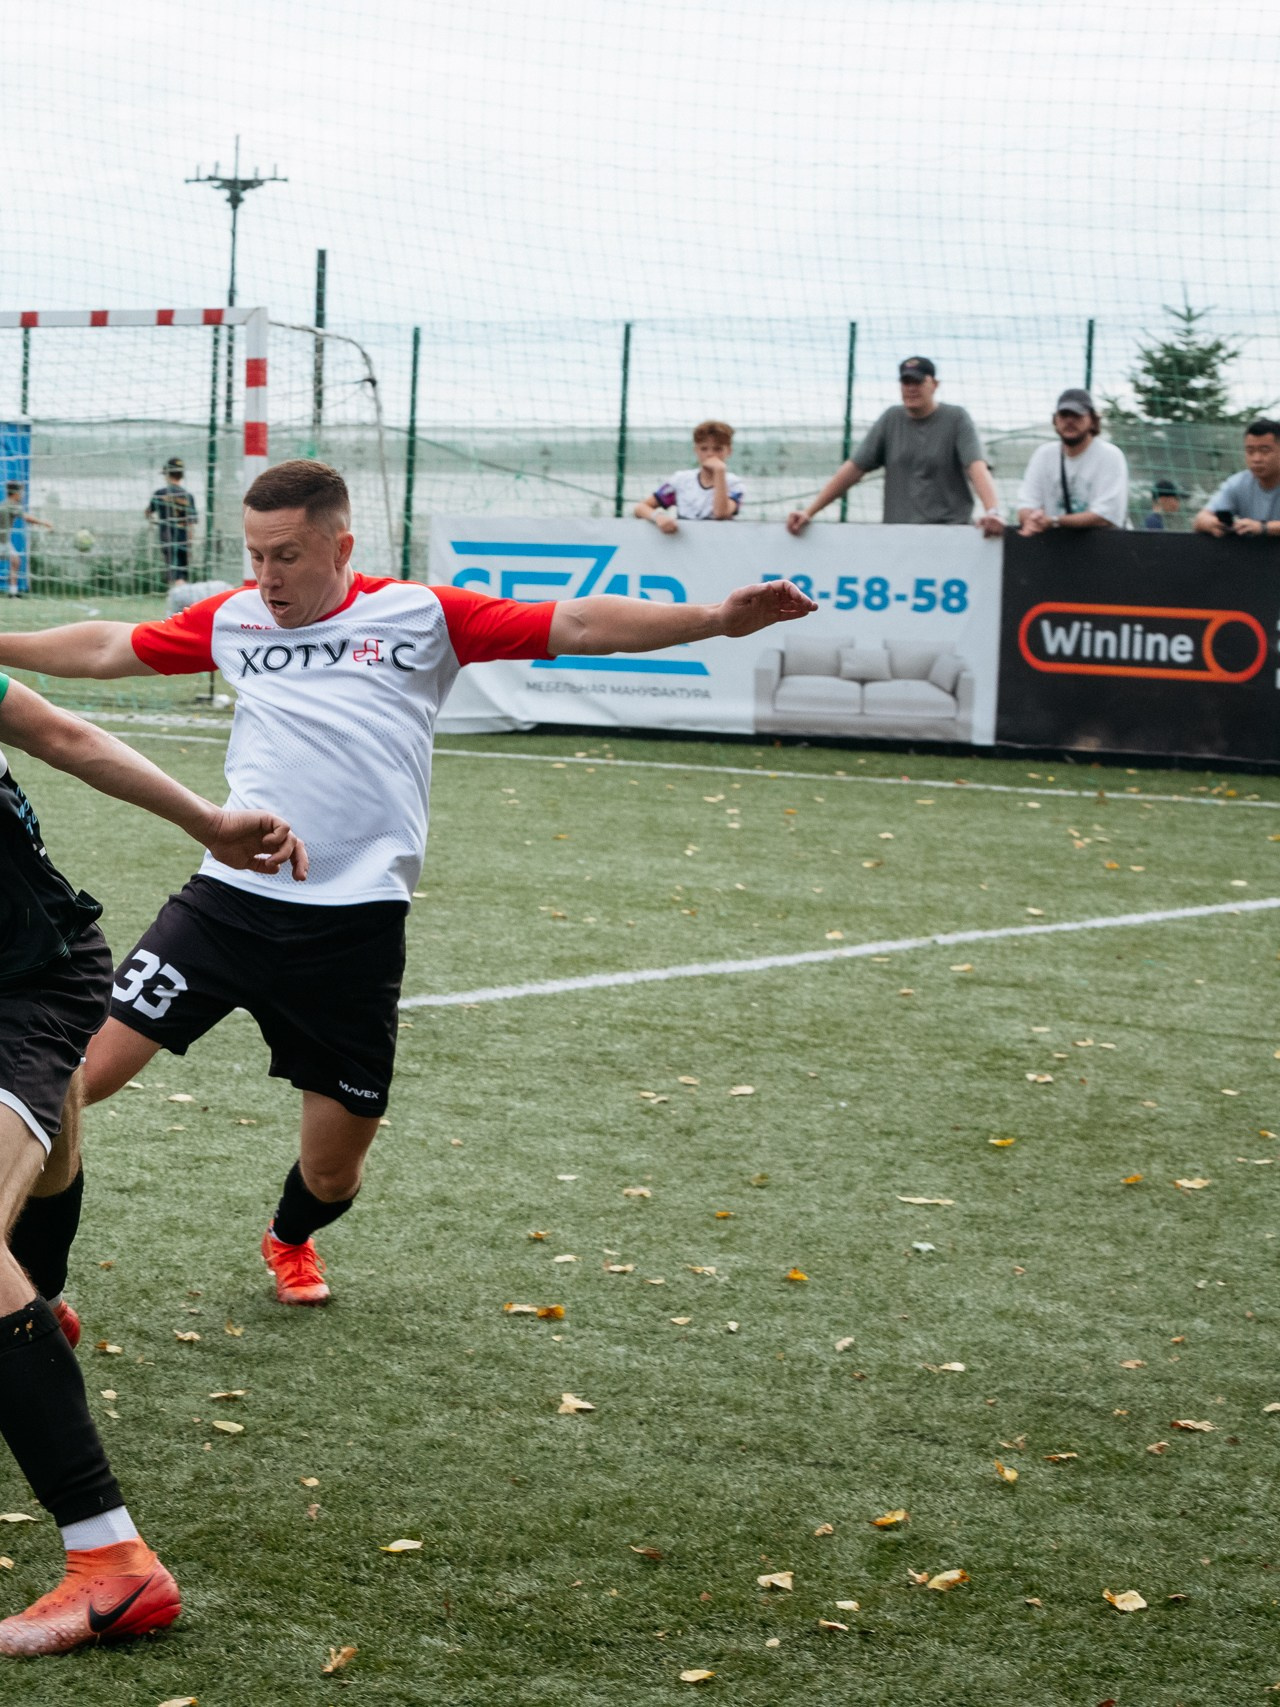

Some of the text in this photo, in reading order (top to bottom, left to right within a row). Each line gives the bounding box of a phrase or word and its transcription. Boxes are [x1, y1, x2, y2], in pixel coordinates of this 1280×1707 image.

[1040, 619, 1194, 664] Winline
[111, 948, 188, 1020] 33
[338, 1080, 380, 1100] MAVEX
